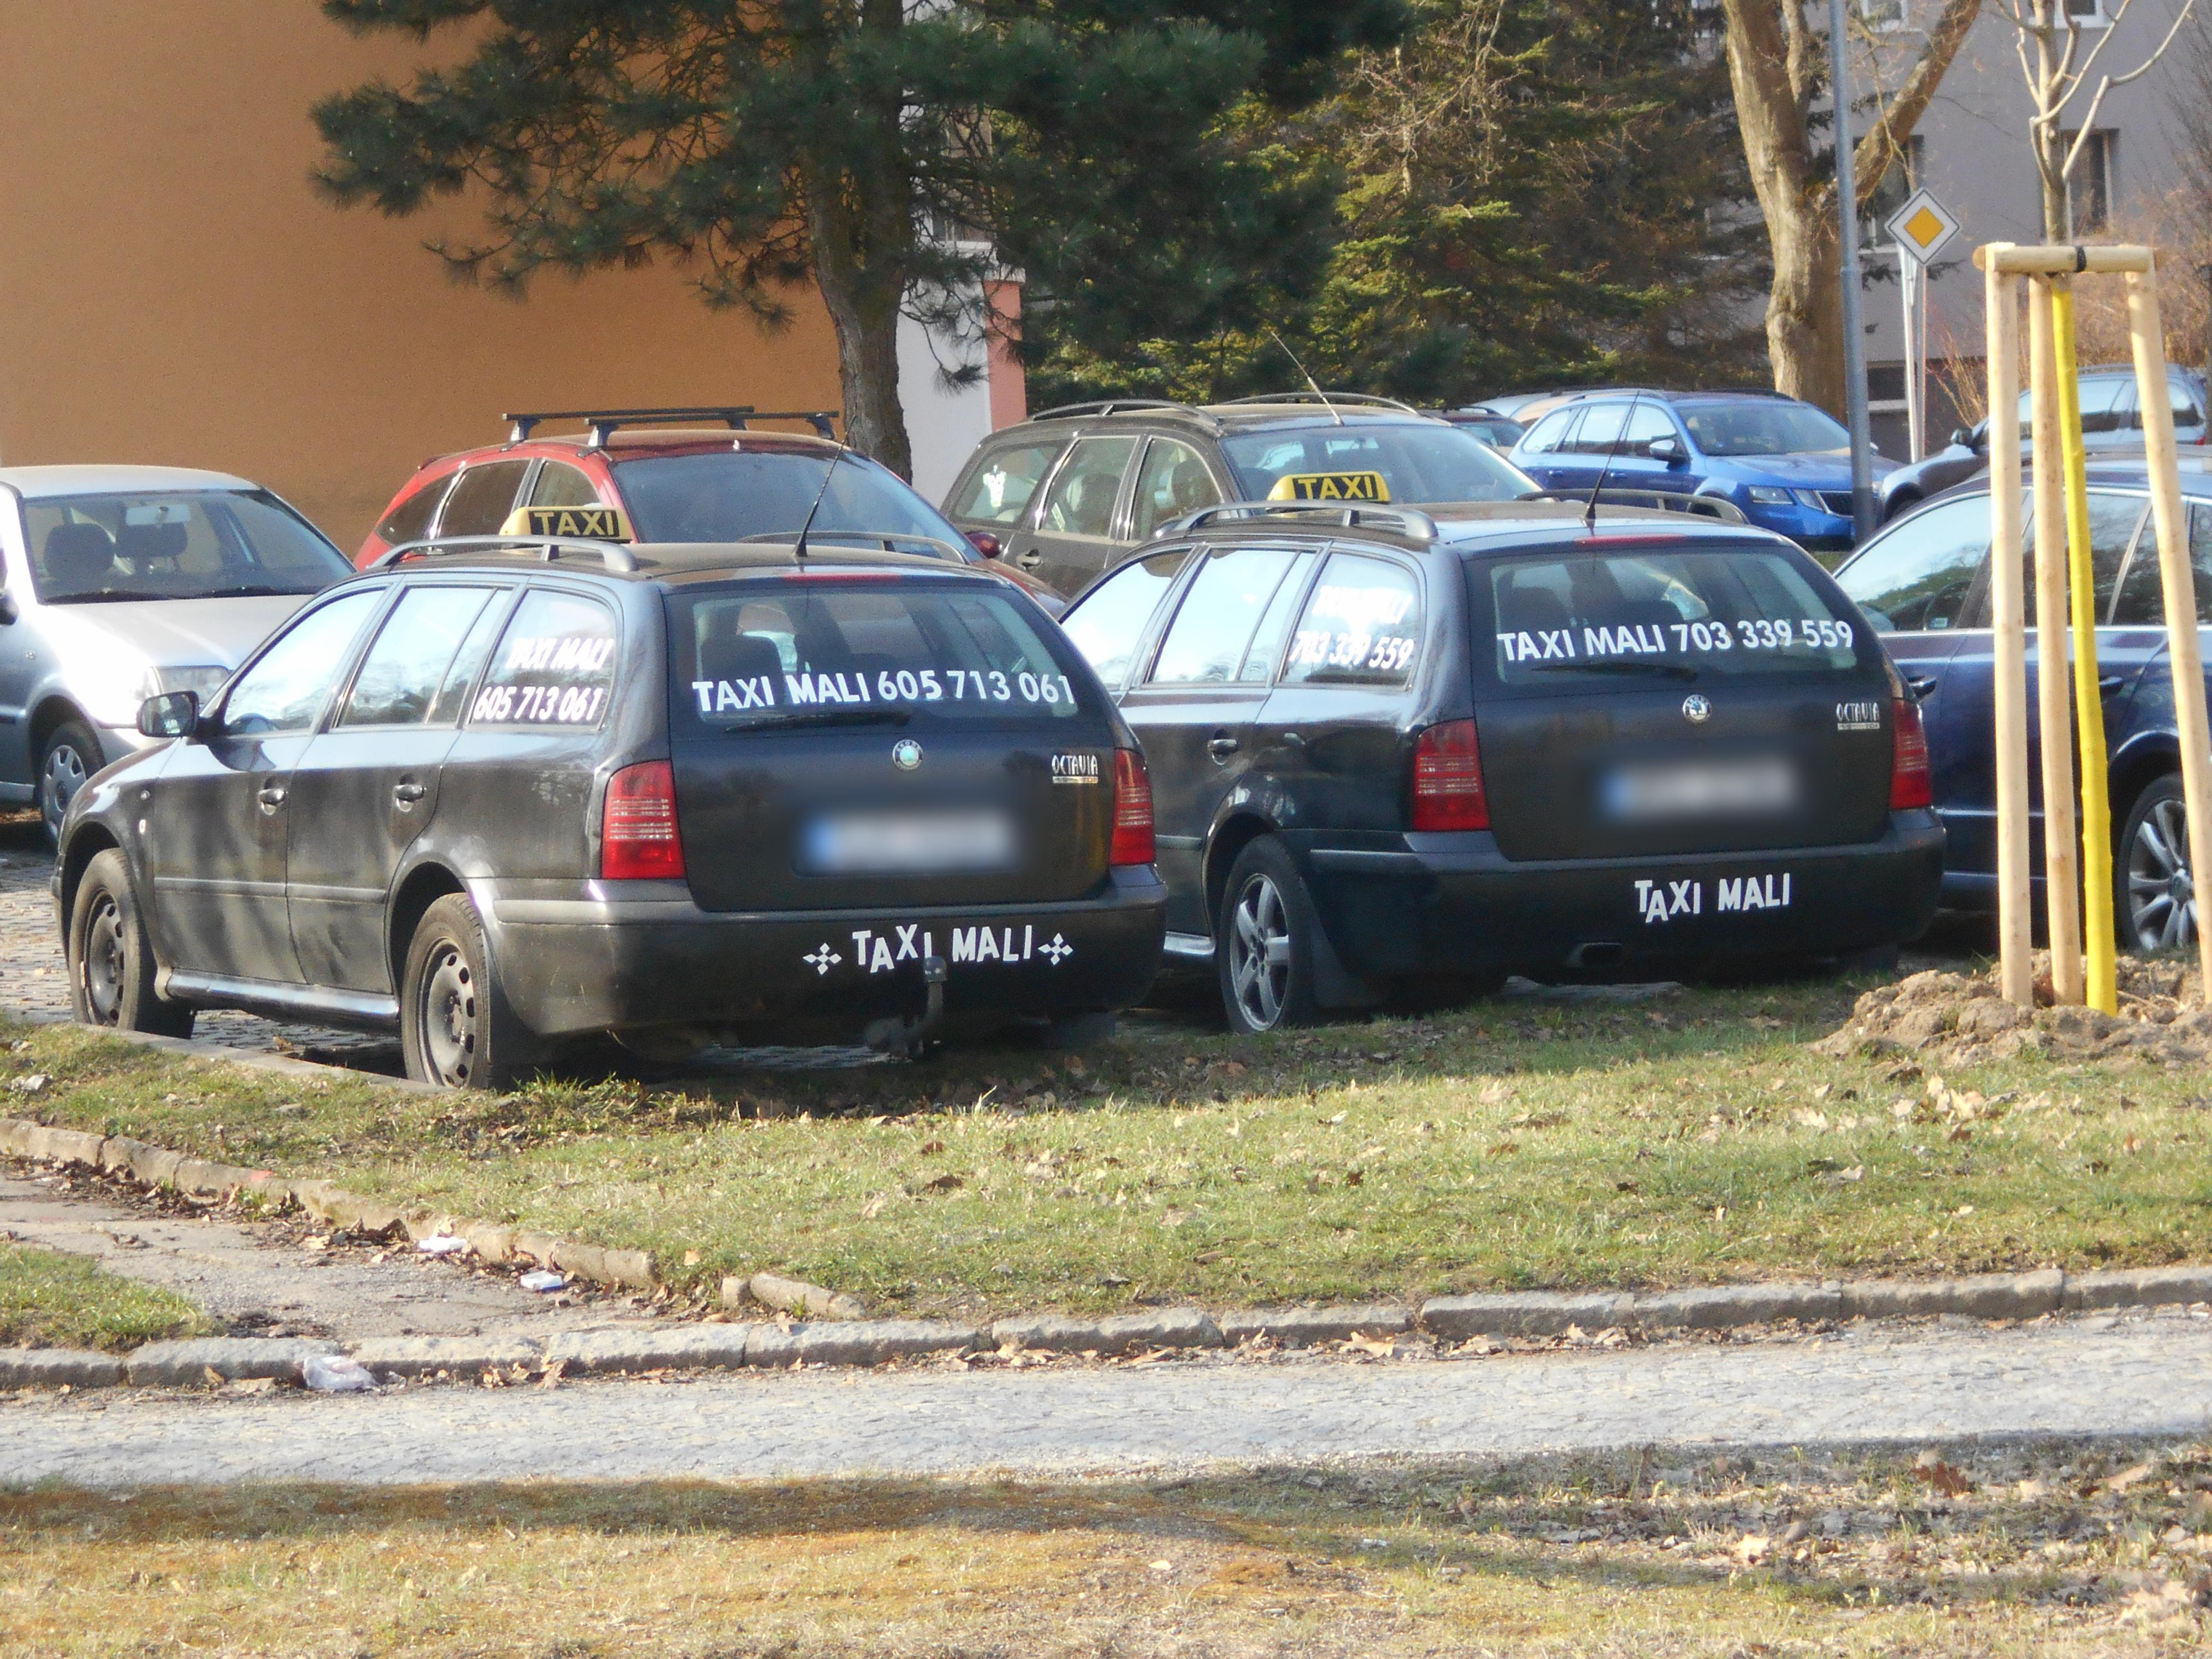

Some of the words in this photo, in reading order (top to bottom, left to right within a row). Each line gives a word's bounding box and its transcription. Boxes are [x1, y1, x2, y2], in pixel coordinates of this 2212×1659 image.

[1298, 476, 1374, 499] TAXI
[534, 511, 614, 536] TAXI
[1369, 637, 1414, 669] 559
[1496, 630, 1575, 660] TAXI
[1584, 625, 1665, 655] MALI
[1671, 622, 1731, 651] 703
[1741, 620, 1793, 648] 339
[1802, 620, 1852, 647] 559
[474, 686, 517, 720] 605
[514, 686, 560, 720] 713
[558, 687, 603, 721] 061
[692, 676, 774, 711] TAXI
[785, 673, 870, 703] MALI
[878, 670, 942, 700] 605
[947, 671, 1010, 700] 713
[1019, 672, 1075, 704] 061
[1837, 702, 1880, 721] OCTAVIA
[1052, 754, 1098, 775] OCTAVIA
[1635, 880, 1700, 922] TAXI
[1718, 873, 1790, 911] MALI
[852, 924, 932, 973] TAXI
[952, 925, 1032, 962] MALI
